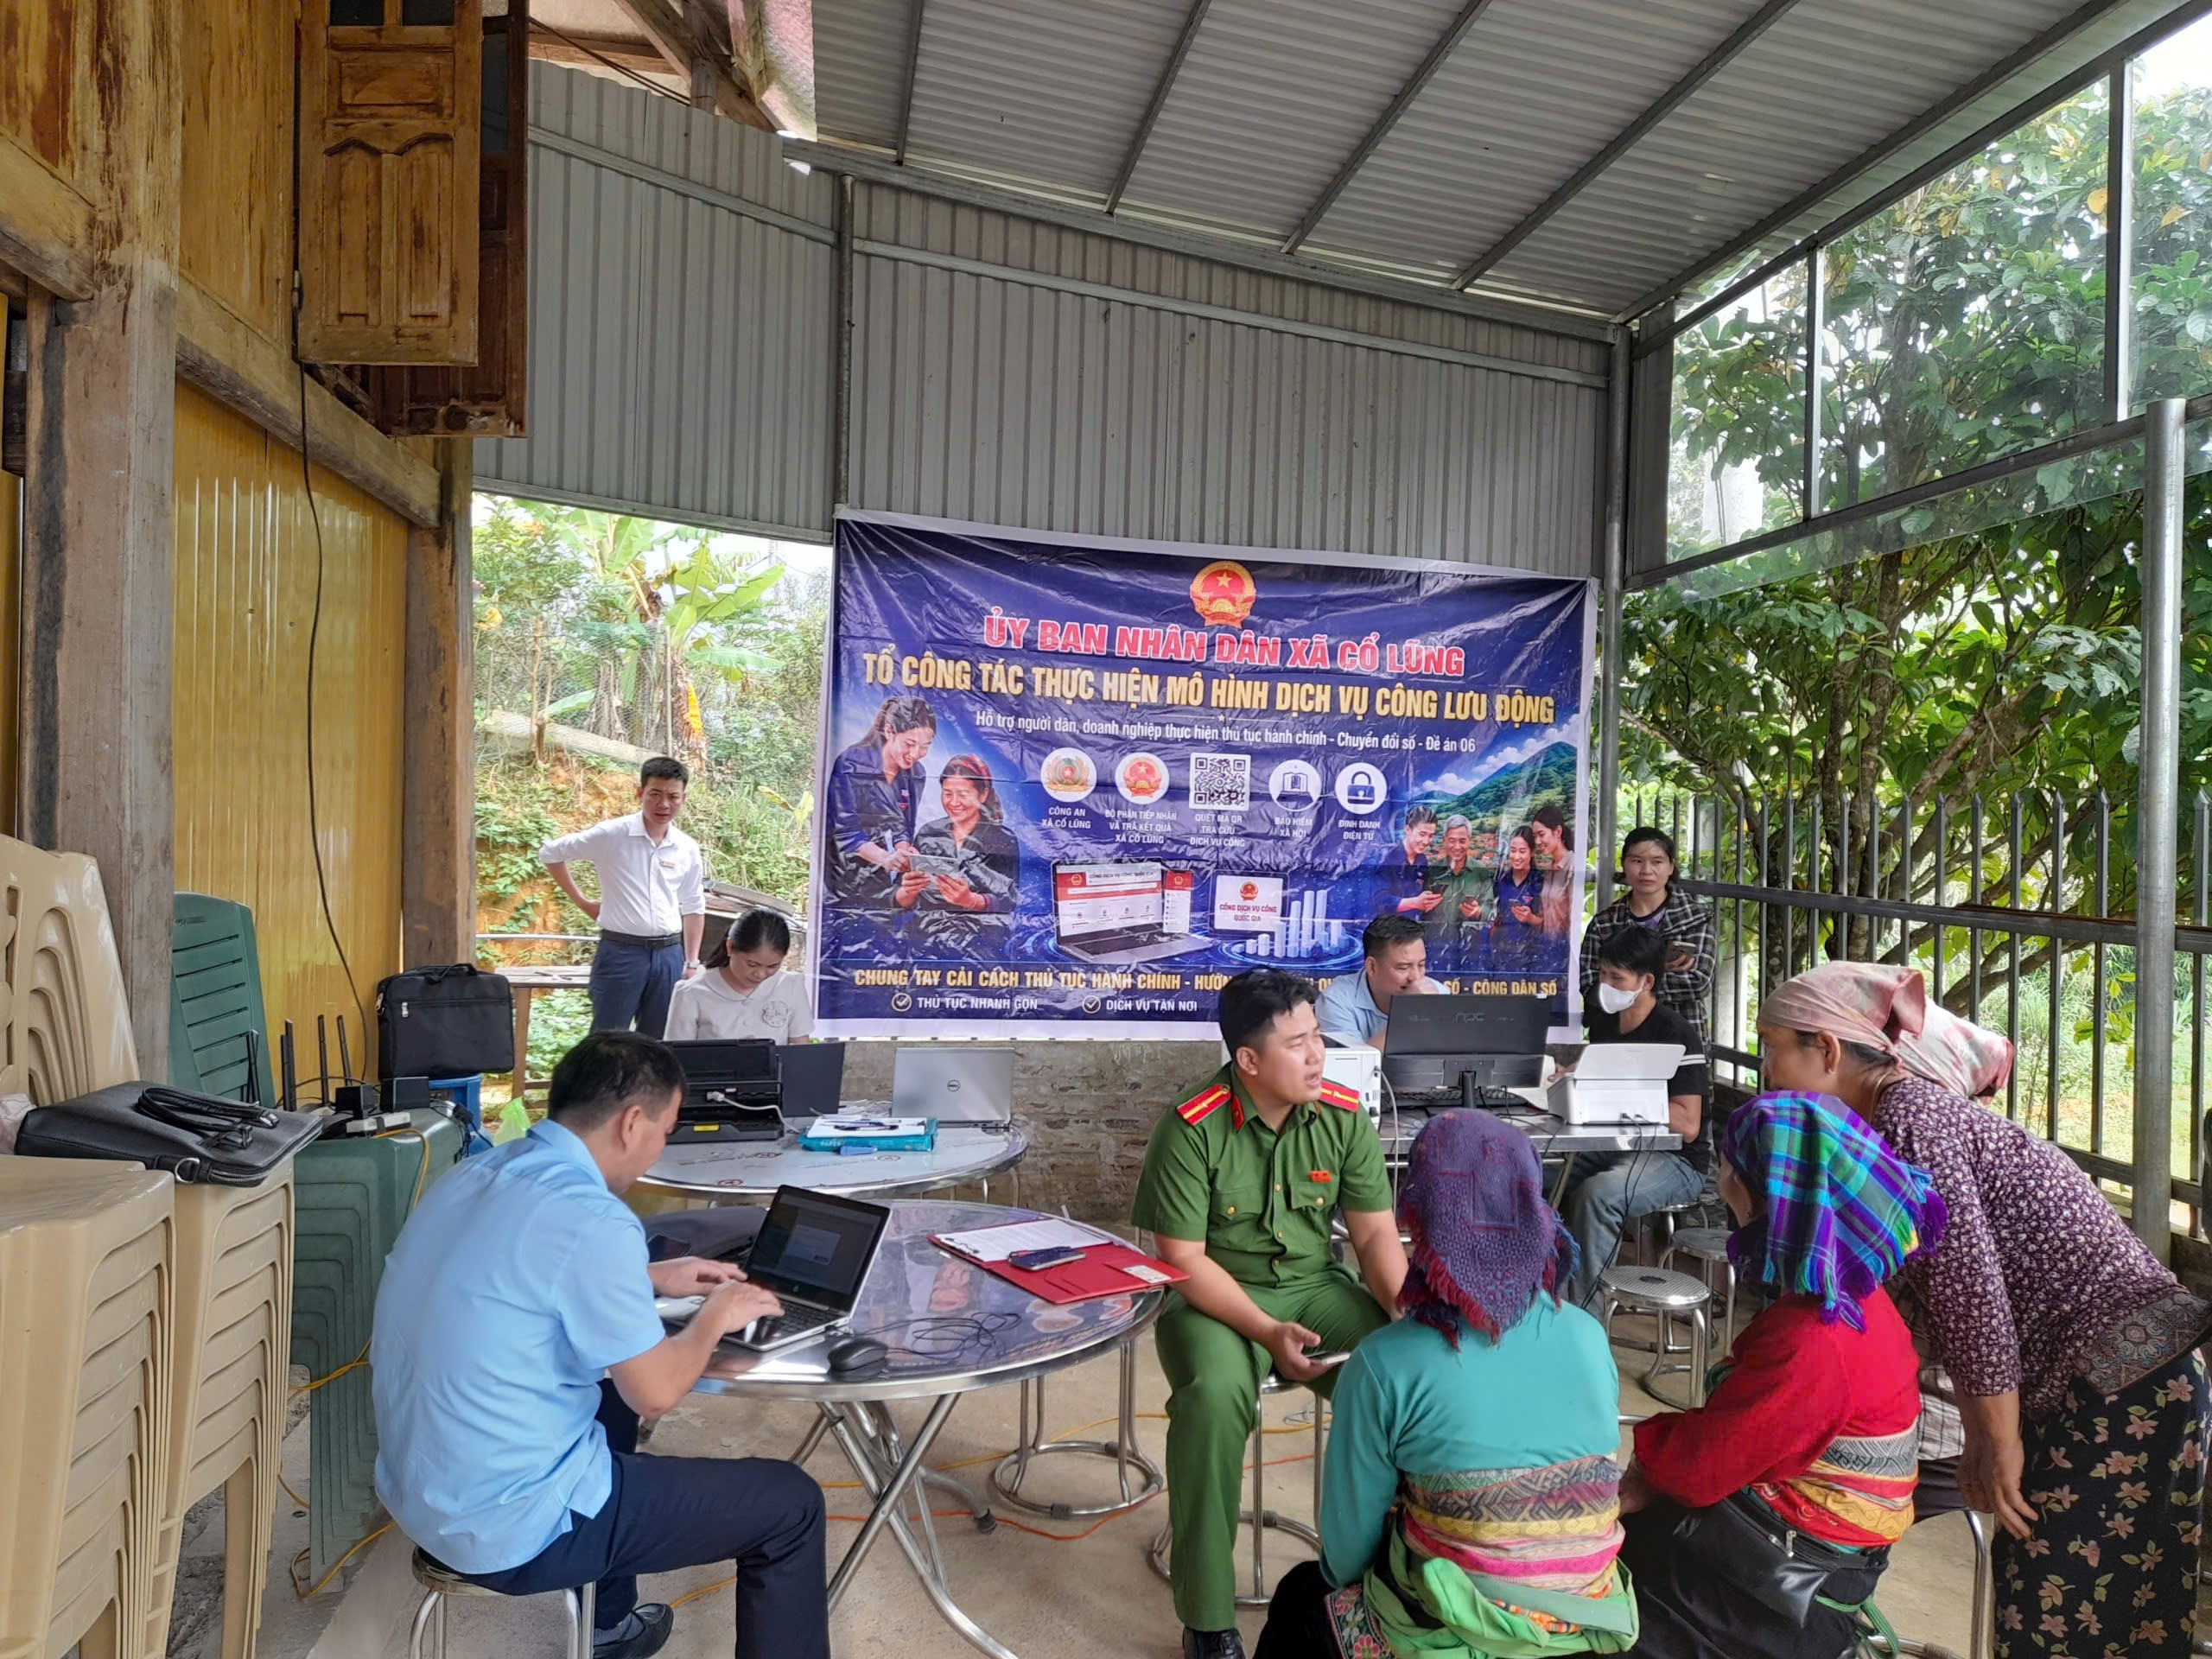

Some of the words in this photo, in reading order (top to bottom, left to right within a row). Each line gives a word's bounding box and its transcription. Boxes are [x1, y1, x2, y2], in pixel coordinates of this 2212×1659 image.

[984, 606, 1029, 648] ỦY
[1038, 620, 1108, 655] BAN
[1116, 624, 1207, 661] NHÂN
[1215, 630, 1280, 665] DÂN
[1287, 634, 1330, 668] XÃ
[1338, 632, 1380, 671] CỔ
[1387, 639, 1465, 677] LŨNG
[863, 644, 895, 685] TỔ
[901, 651, 972, 690] CÔNG
[979, 658, 1024, 695] TÁC
[1032, 666, 1094, 705] THỰC
[1103, 667, 1159, 709] HIỆN
[1166, 671, 1204, 706] MÔ
[1211, 674, 1268, 709] HÌNH
[1275, 683, 1331, 717] DỊCH
[1339, 685, 1369, 721] VỤ
[1376, 683, 1437, 718] CÔNG
[1444, 690, 1488, 721] LƯU
[1496, 689, 1554, 728] ĐỘNG
[976, 709, 994, 727] Hỗ
[997, 714, 1014, 732] trợ
[1018, 715, 1052, 734] người
[1054, 716, 1080, 734] dân,
[1083, 720, 1119, 735] doanh
[1122, 721, 1161, 741] nghiệp
[1166, 723, 1191, 741] thực
[1193, 724, 1218, 742] hiện
[1222, 725, 1240, 742] thủ
[1243, 728, 1262, 746] tục
[1265, 728, 1293, 744] hành
[1338, 731, 1378, 753] Chuyển
[1382, 733, 1399, 748] đổi
[1402, 733, 1415, 750] số
[1426, 734, 1441, 751] Đề
[1444, 736, 1456, 751] án
[1460, 737, 1476, 753] 06
[1049, 805, 1071, 816] CÔNG
[1074, 808, 1085, 817] AN
[1202, 825, 1217, 834] TRA
[1358, 820, 1381, 829] DANH
[1190, 836, 1210, 847] DỊCH
[1223, 836, 1245, 847] CÔNG
[855, 969, 909, 986] CHUNG
[915, 969, 942, 986] TAY
[946, 966, 972, 987] CẢI
[978, 968, 1020, 988] CÁCH
[1025, 968, 1053, 988] THỦ
[1058, 972, 1087, 990] TỤC
[1092, 969, 1132, 988] HÀNH
[1137, 970, 1180, 989] CHÍNH
[1472, 978, 1508, 994] CÔNG
[1512, 979, 1537, 995] DÂN
[1541, 978, 1557, 995] SỐ
[917, 994, 940, 1008] THỦ
[945, 997, 967, 1011] TỤC
[970, 997, 1010, 1009] NHANH
[1014, 998, 1037, 1012] GỌN
[1106, 1000, 1132, 1013] DỊCH
[1135, 1001, 1150, 1013] VỤ
[1154, 999, 1175, 1014] TẬN
[1179, 1000, 1198, 1011] NƠI
